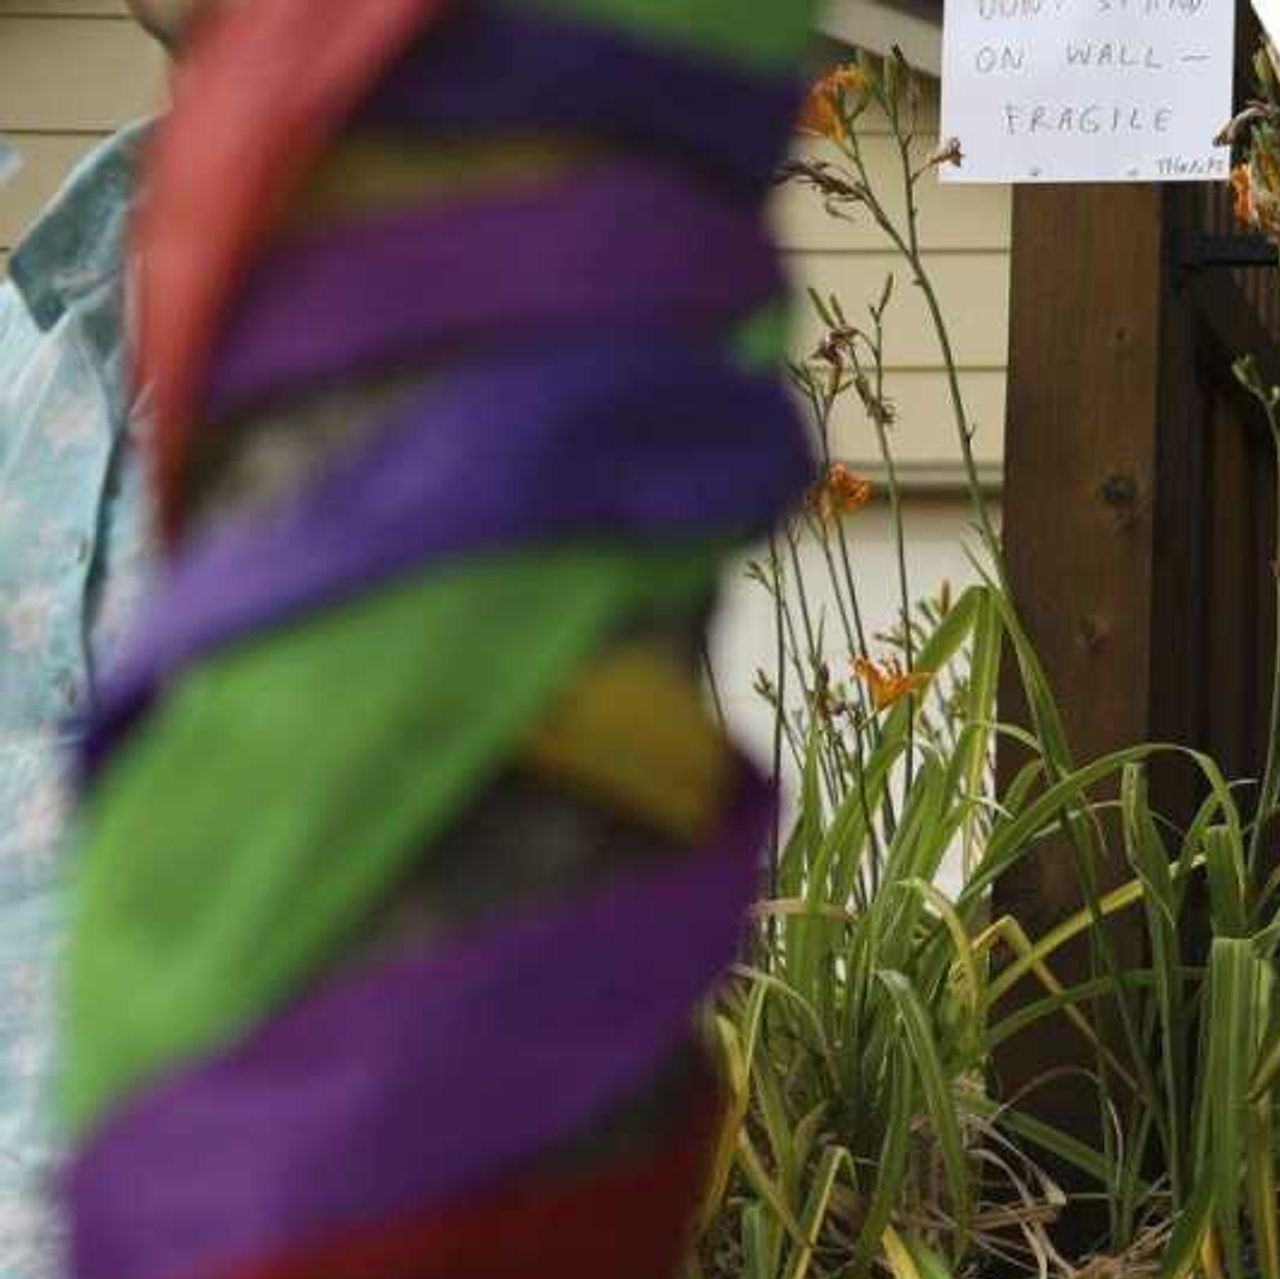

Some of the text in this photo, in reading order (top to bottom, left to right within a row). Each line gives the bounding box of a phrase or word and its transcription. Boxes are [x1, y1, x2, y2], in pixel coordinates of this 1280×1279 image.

[976, 45, 1025, 74] ON
[1065, 43, 1165, 69] WALL
[1004, 104, 1174, 135] FRAGILE
